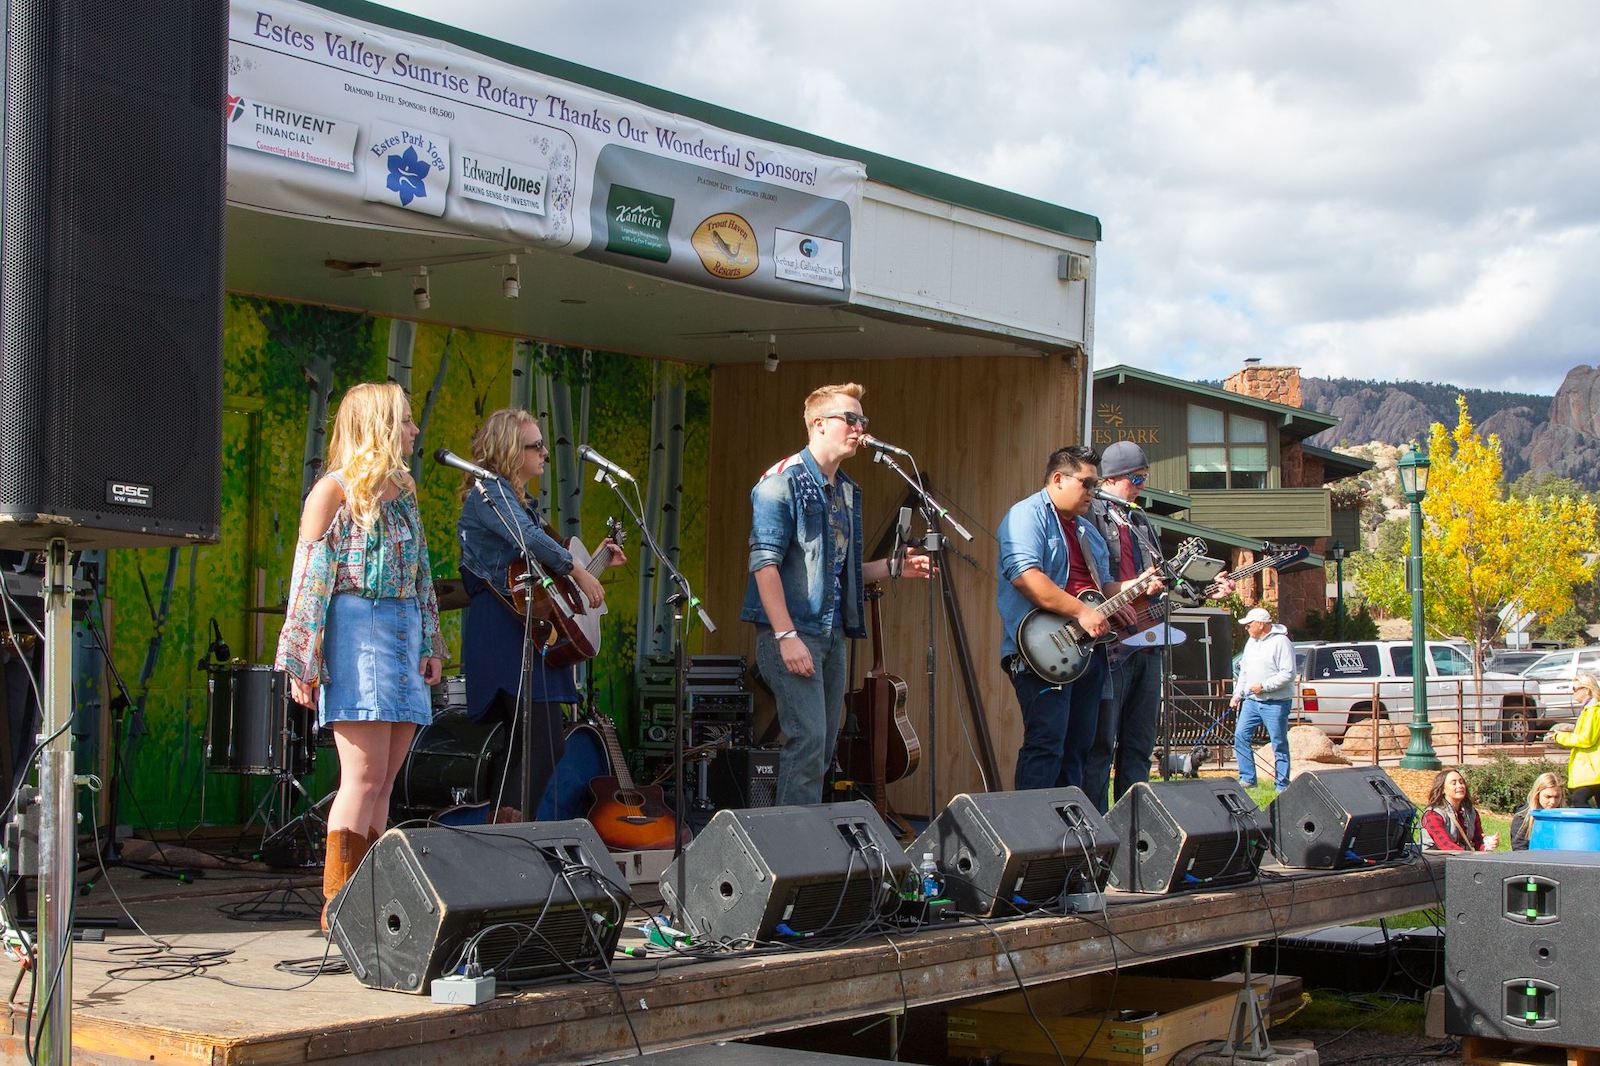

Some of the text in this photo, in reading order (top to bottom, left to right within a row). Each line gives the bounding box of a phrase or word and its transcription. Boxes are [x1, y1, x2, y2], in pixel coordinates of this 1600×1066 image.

[254, 11, 818, 187] Estes Valley Sunrise Rotary Thanks Our Wonderful Sponsors!
[252, 104, 336, 136] THRIVENT
[256, 140, 286, 157] Connecting
[287, 148, 300, 158] faith
[306, 152, 328, 164] finances
[328, 158, 336, 167] for
[370, 130, 446, 172] Estes Park Yoga
[464, 184, 485, 196] MAKING
[486, 190, 502, 200] SENSE
[511, 196, 540, 209] INVESTING
[616, 206, 662, 228] Xanterra
[707, 220, 748, 240] Trout Haven
[713, 261, 741, 276] Resorts
[1118, 430, 1160, 444] PARK
[112, 484, 149, 498] QSC
[755, 765, 774, 774] VOX
